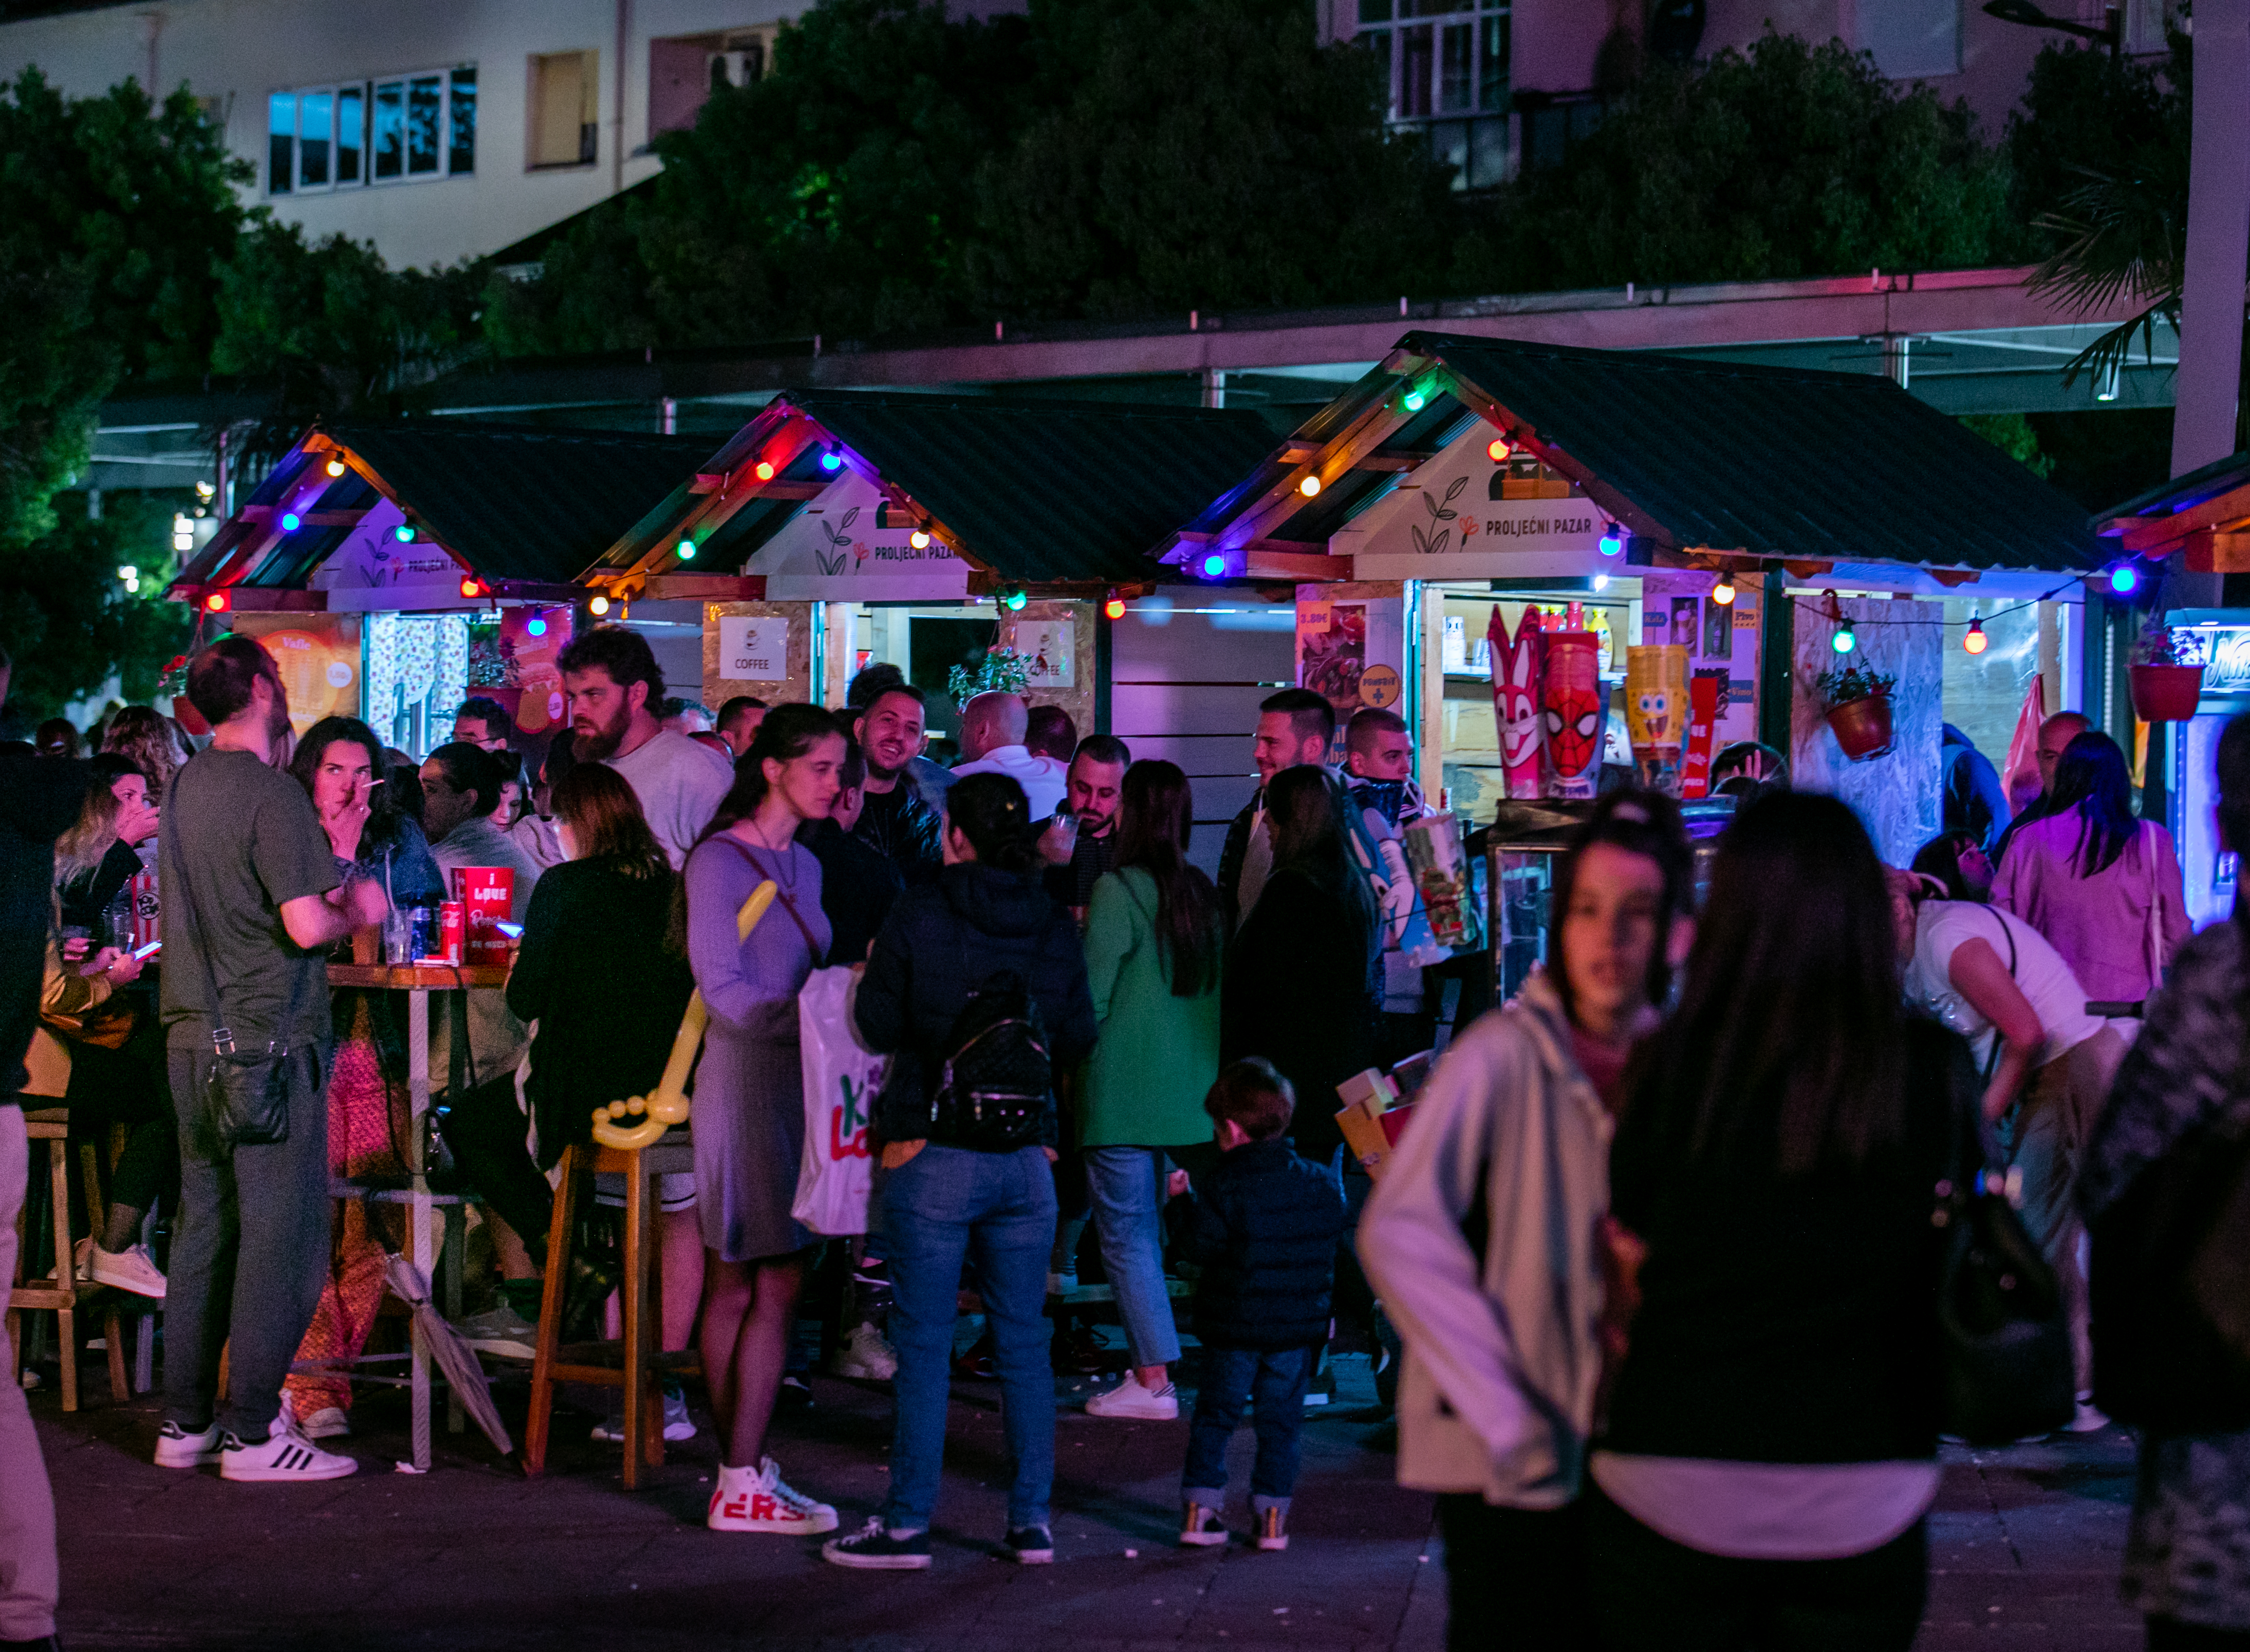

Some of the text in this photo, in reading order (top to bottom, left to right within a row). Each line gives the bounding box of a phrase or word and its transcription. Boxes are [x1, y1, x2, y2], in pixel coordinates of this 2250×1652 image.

[1486, 515, 1591, 537] PROLJEĆNI PAZAR
[735, 659, 769, 669] COFFEE
[474, 888, 507, 904] LOVE
